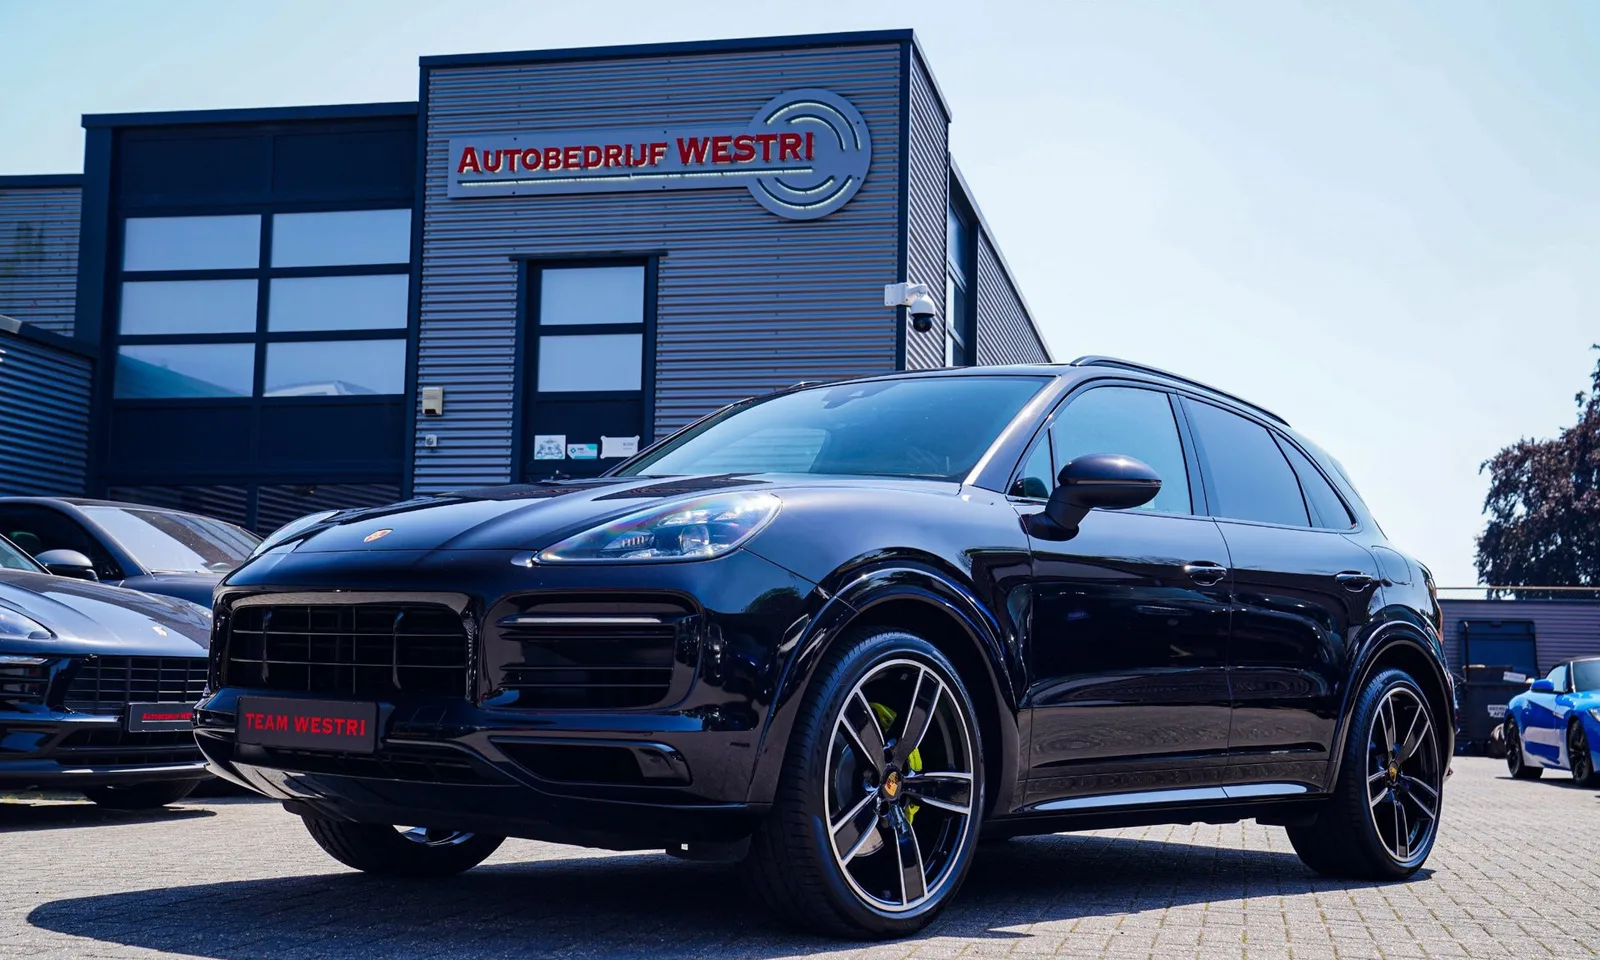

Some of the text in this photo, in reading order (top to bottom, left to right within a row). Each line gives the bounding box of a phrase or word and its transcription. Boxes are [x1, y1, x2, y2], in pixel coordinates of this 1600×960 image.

[457, 131, 814, 174] AUTOBEDRIJF WESTRI
[245, 712, 367, 737] TEAM WESTRI
